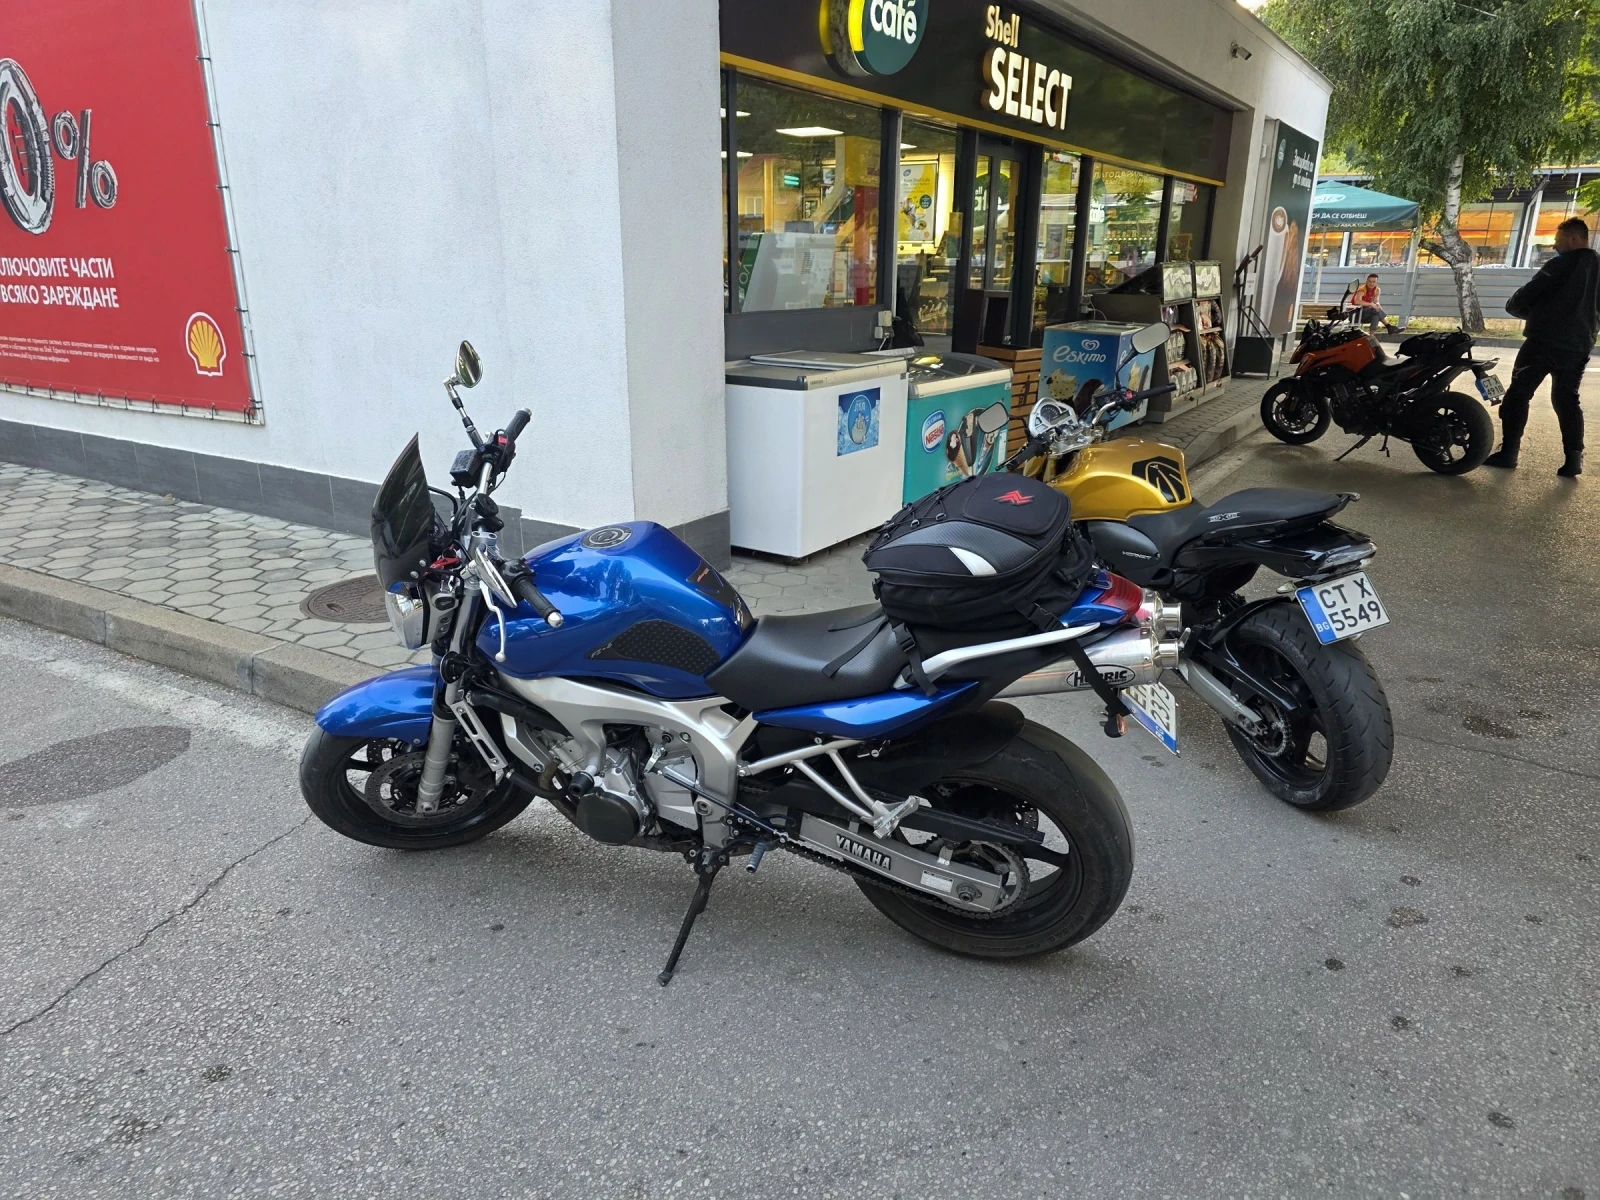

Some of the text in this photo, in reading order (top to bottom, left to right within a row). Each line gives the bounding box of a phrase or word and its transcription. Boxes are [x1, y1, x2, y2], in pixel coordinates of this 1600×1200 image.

[985, 5, 1020, 48] Shell
[987, 47, 1072, 130] SELECT
[69, 257, 115, 278] ЧАСТИ
[40, 285, 120, 310] ЗАРЕЖДАНЕ
[1319, 577, 1373, 609] CT X
[1315, 621, 1330, 633] BG
[1328, 600, 1381, 632] 5549
[835, 834, 892, 871] YAMAHA
